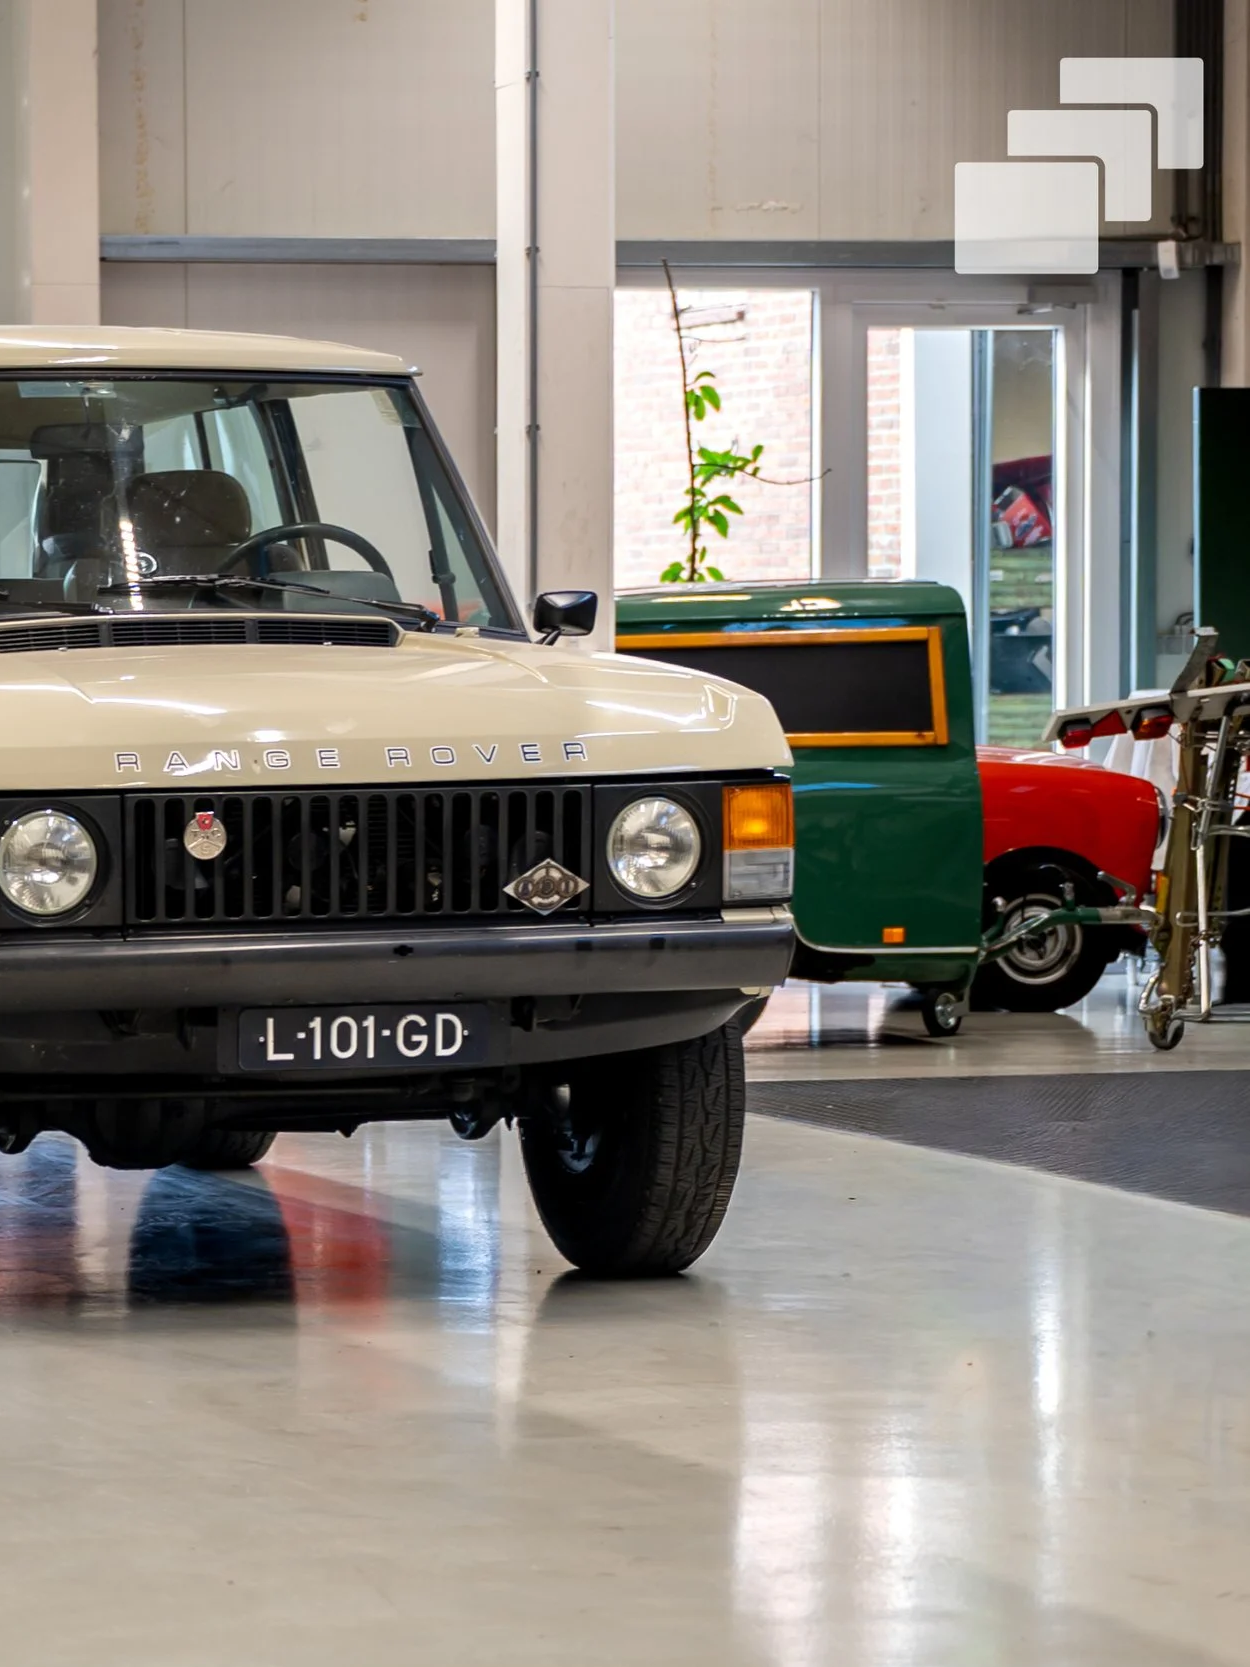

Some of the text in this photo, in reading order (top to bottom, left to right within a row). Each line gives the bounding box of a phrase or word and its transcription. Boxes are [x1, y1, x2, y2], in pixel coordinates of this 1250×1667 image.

[114, 741, 589, 773] RANGE ROVER
[266, 1012, 463, 1061] L-101-GD
